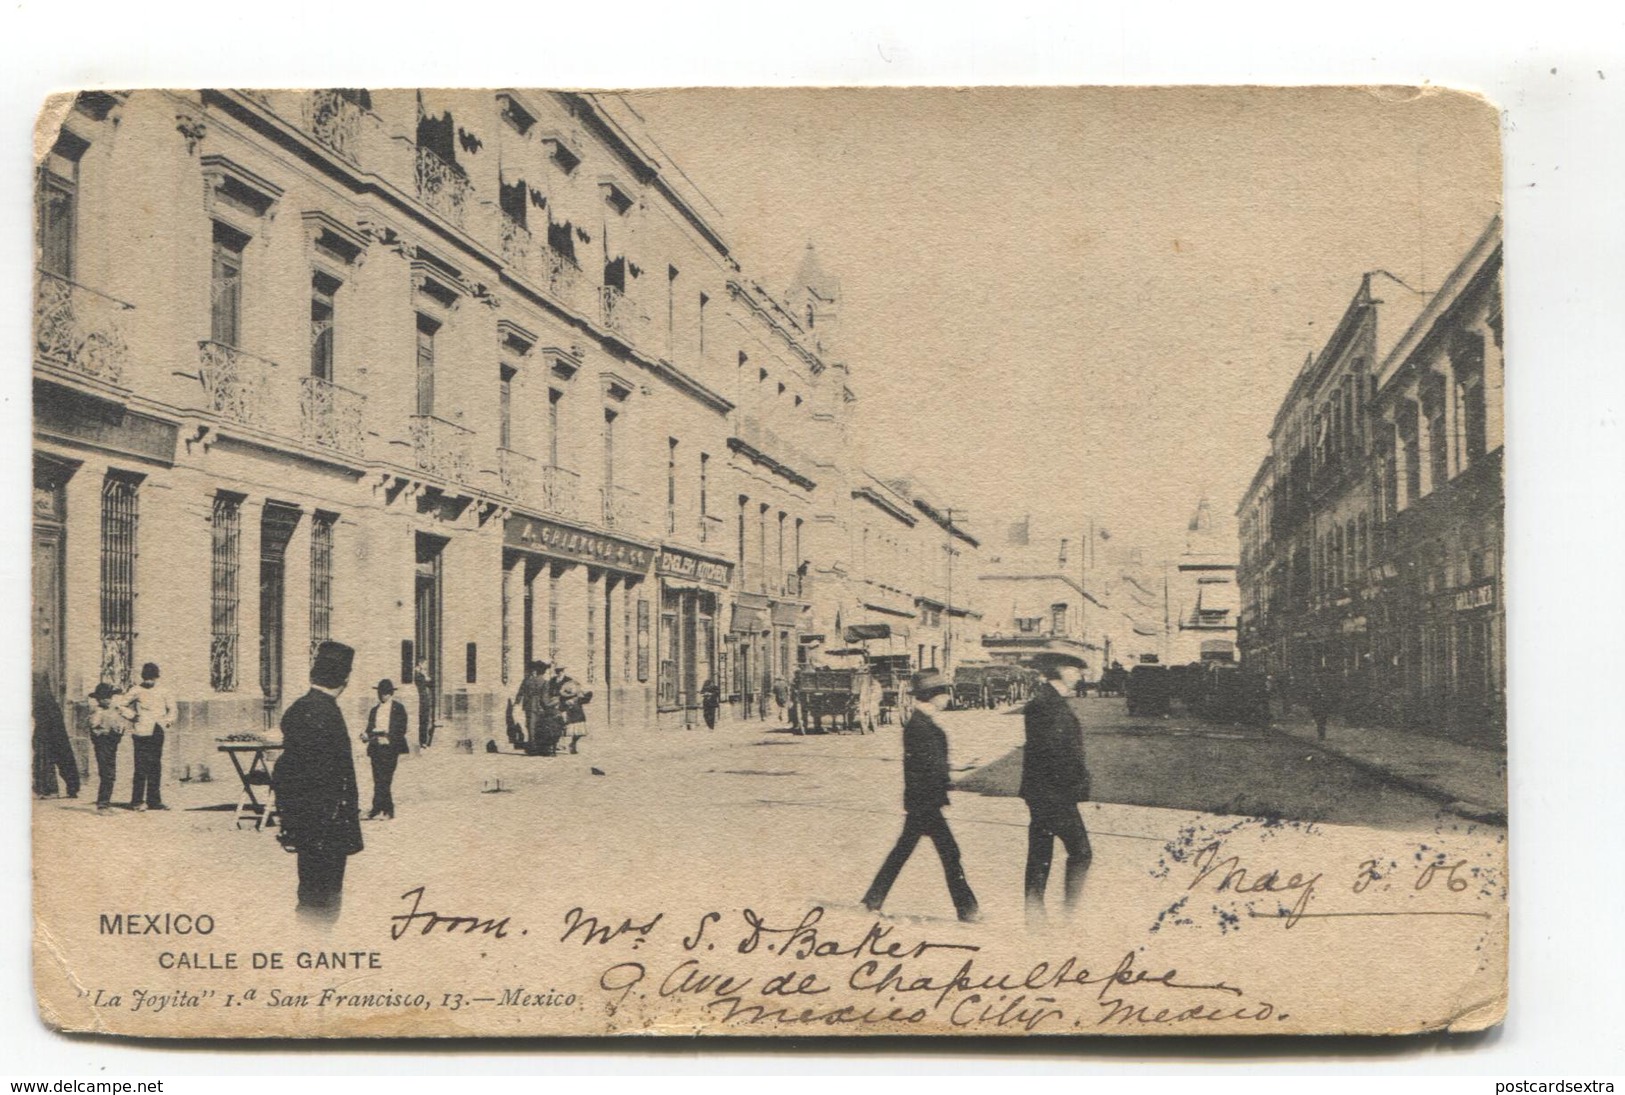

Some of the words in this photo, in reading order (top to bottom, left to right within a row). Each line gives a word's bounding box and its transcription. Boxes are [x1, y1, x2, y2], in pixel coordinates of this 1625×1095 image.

[1188, 840, 1323, 929] May
[99, 913, 216, 936] MEXICO
[776, 906, 981, 960] Baker
[158, 951, 239, 970] CALLE
[252, 951, 285, 970] DE
[296, 951, 383, 970] GANTE
[659, 959, 754, 998] Ave
[761, 970, 831, 996] de
[266, 988, 310, 1008] San
[316, 987, 432, 1010] Francisco,
